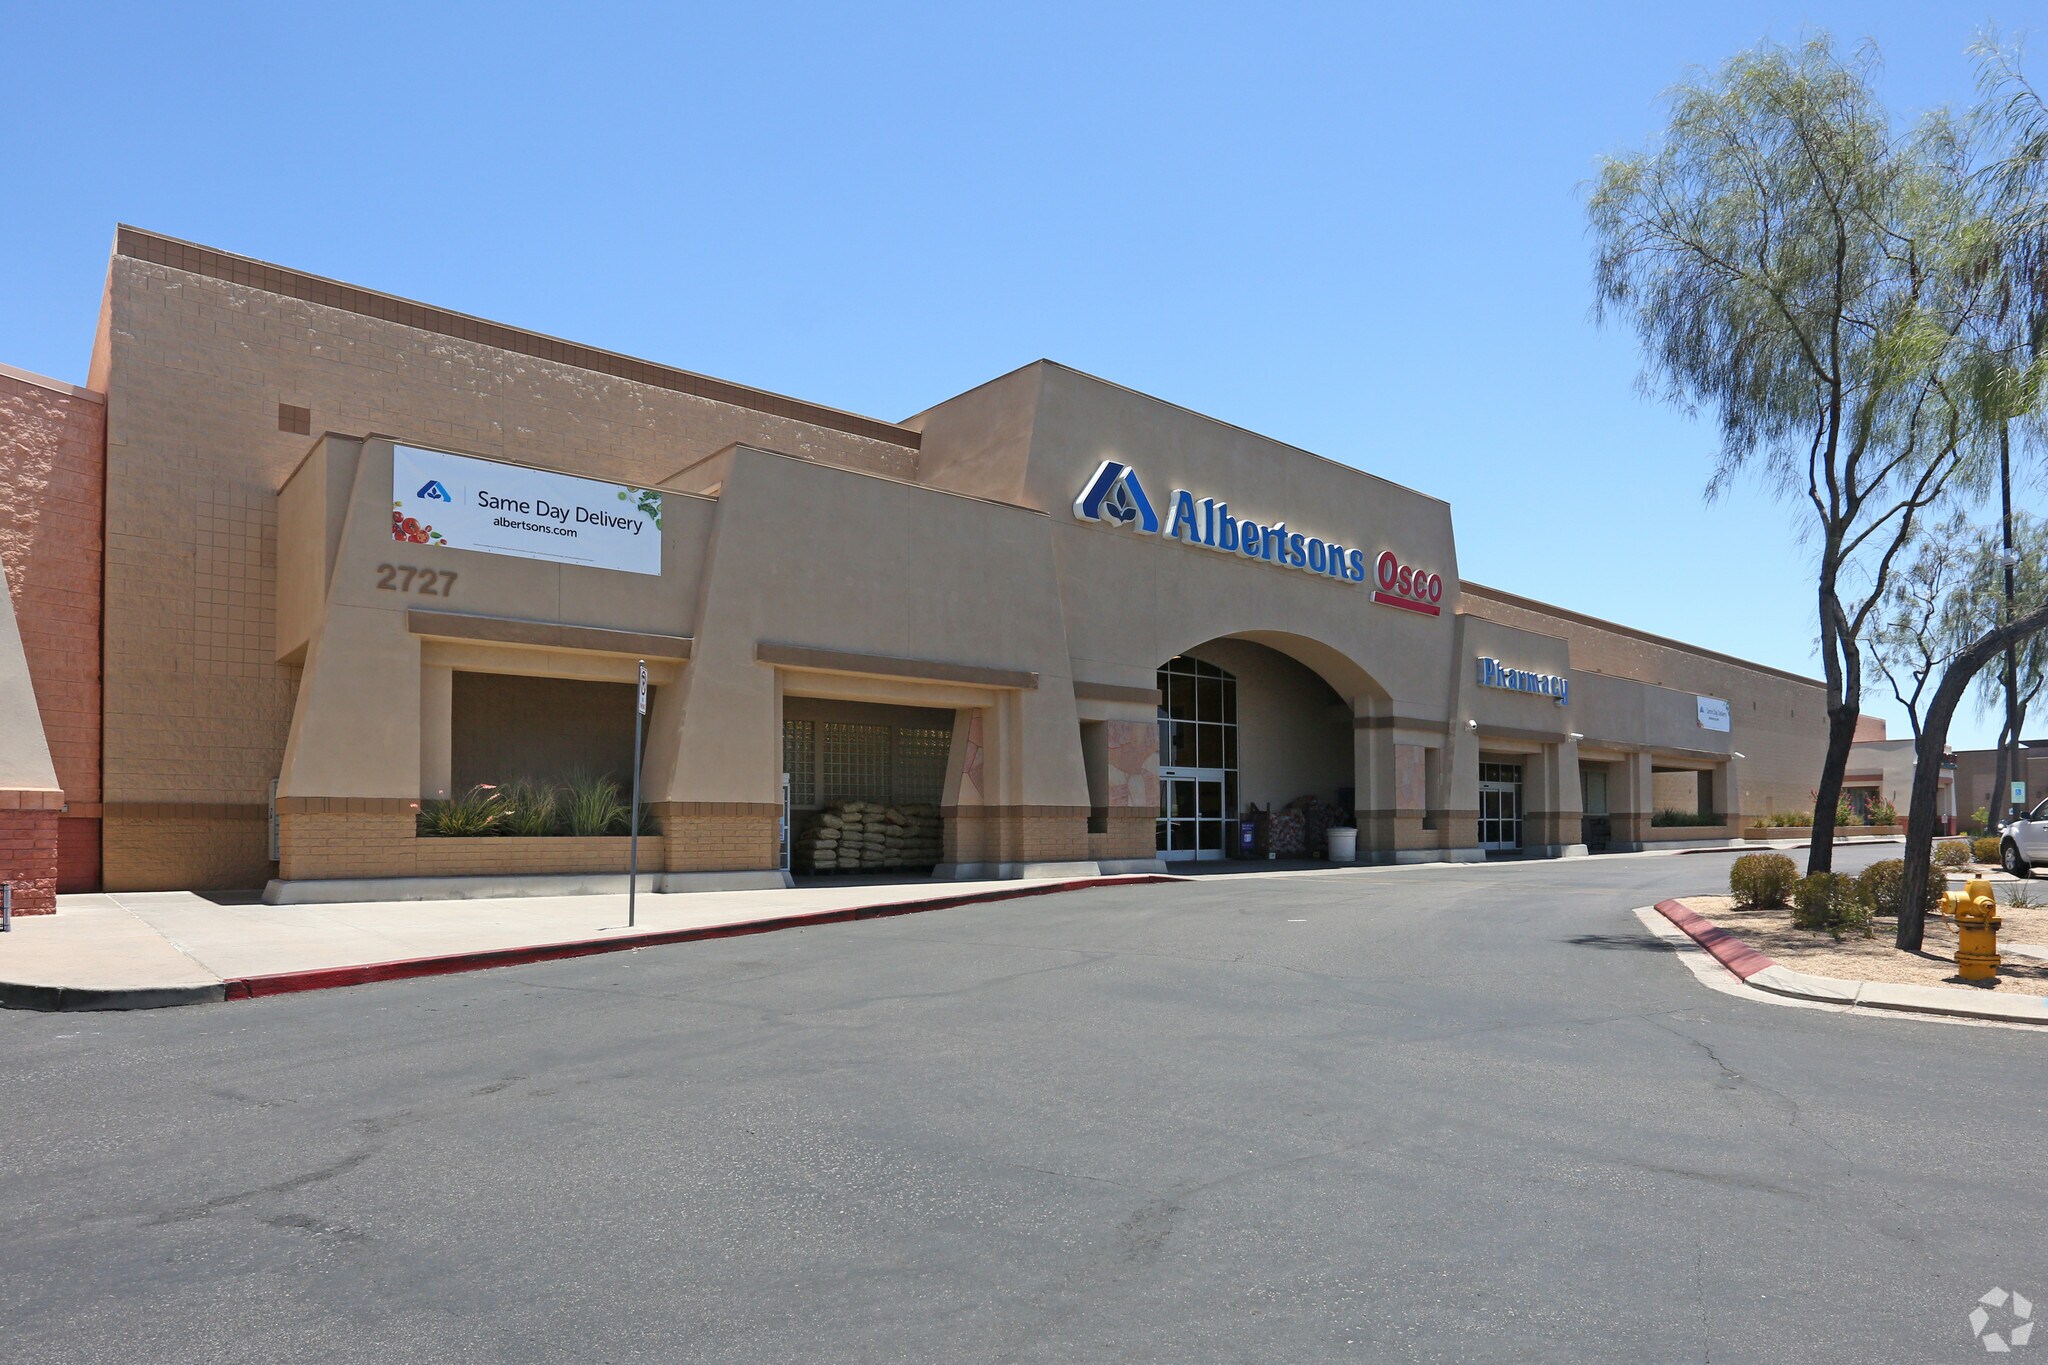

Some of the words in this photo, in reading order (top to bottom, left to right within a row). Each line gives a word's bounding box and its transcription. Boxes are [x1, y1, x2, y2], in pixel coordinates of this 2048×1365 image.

[478, 490, 530, 515] Same
[536, 500, 570, 523] Day
[575, 506, 643, 535] Delivery
[493, 516, 578, 538] albertsons.com
[1163, 488, 1365, 584] Albertsons
[376, 563, 458, 597] 2727
[1374, 550, 1442, 604] Osco
[1477, 656, 1569, 706] Pharmacy
